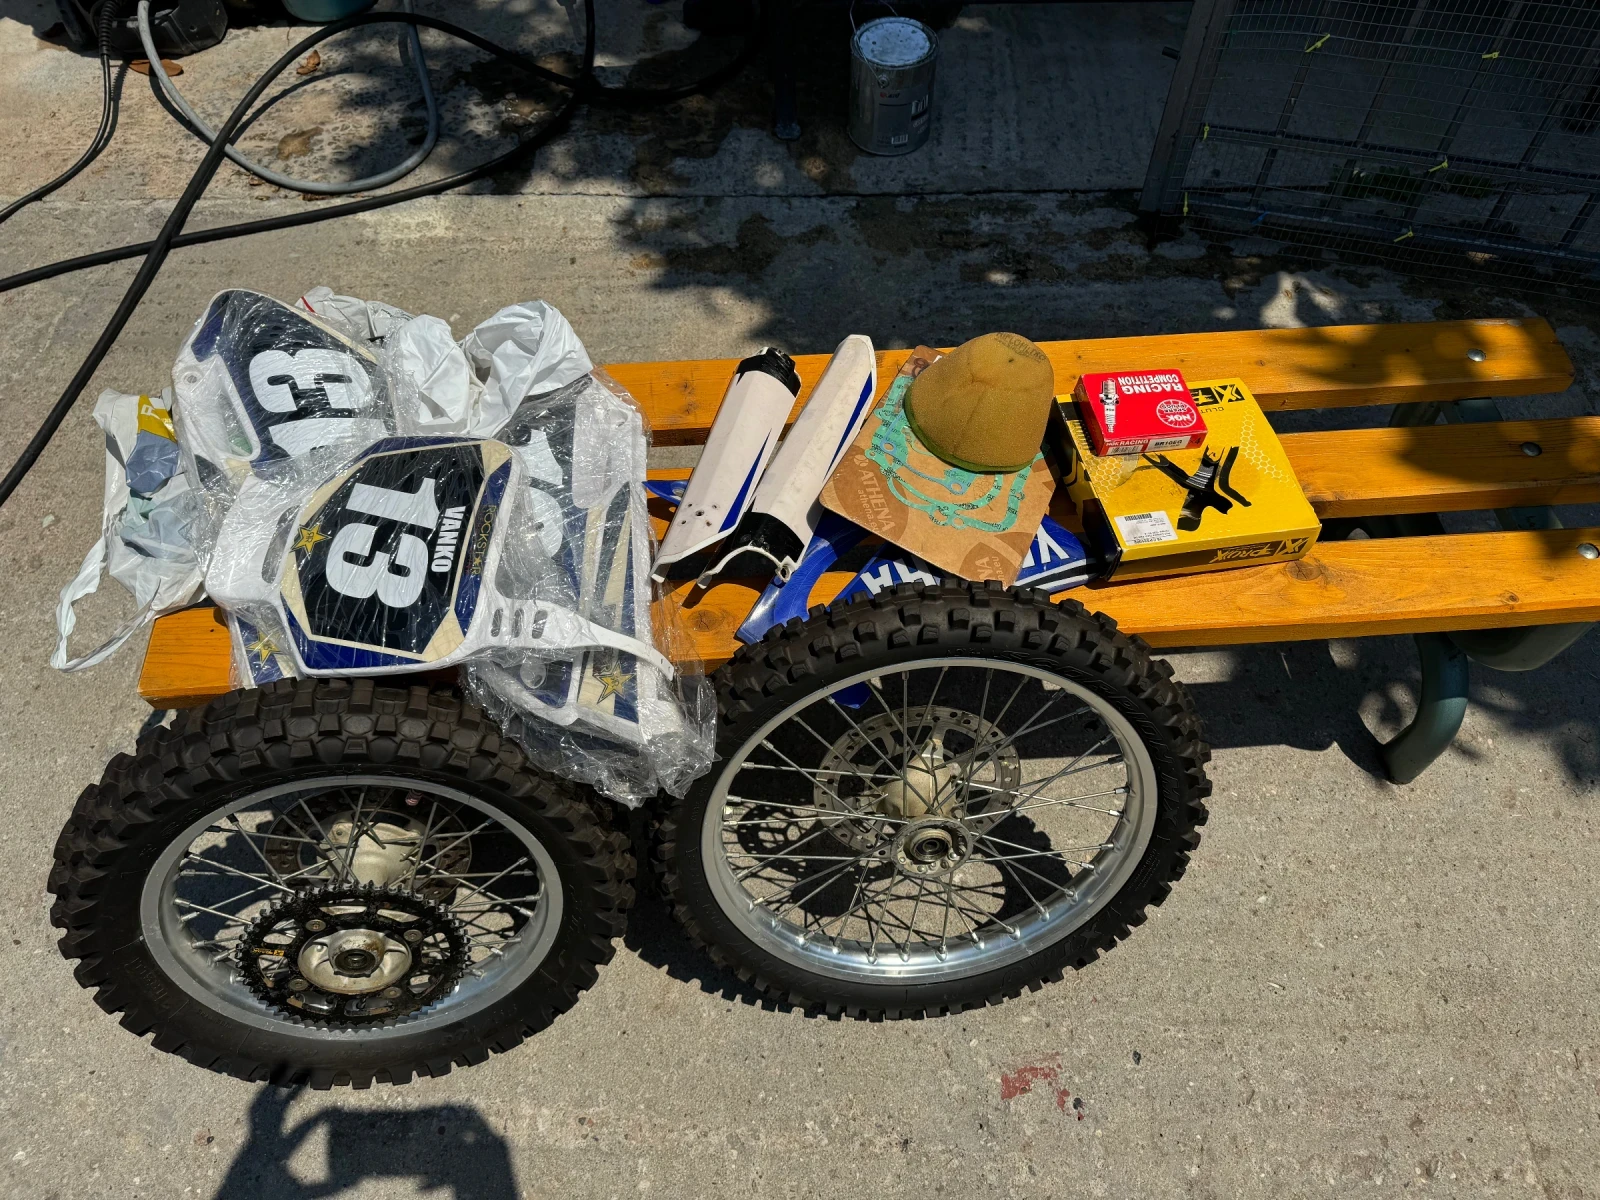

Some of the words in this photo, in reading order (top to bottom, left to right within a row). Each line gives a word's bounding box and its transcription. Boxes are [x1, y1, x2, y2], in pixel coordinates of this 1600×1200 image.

[248, 348, 389, 457] 13
[1117, 373, 1179, 385] COMPETITION
[1121, 382, 1184, 395] RACING
[1165, 413, 1192, 422] NGK
[859, 469, 896, 533] ATHENA
[325, 478, 439, 609] 13
[430, 505, 467, 573] VANKO
